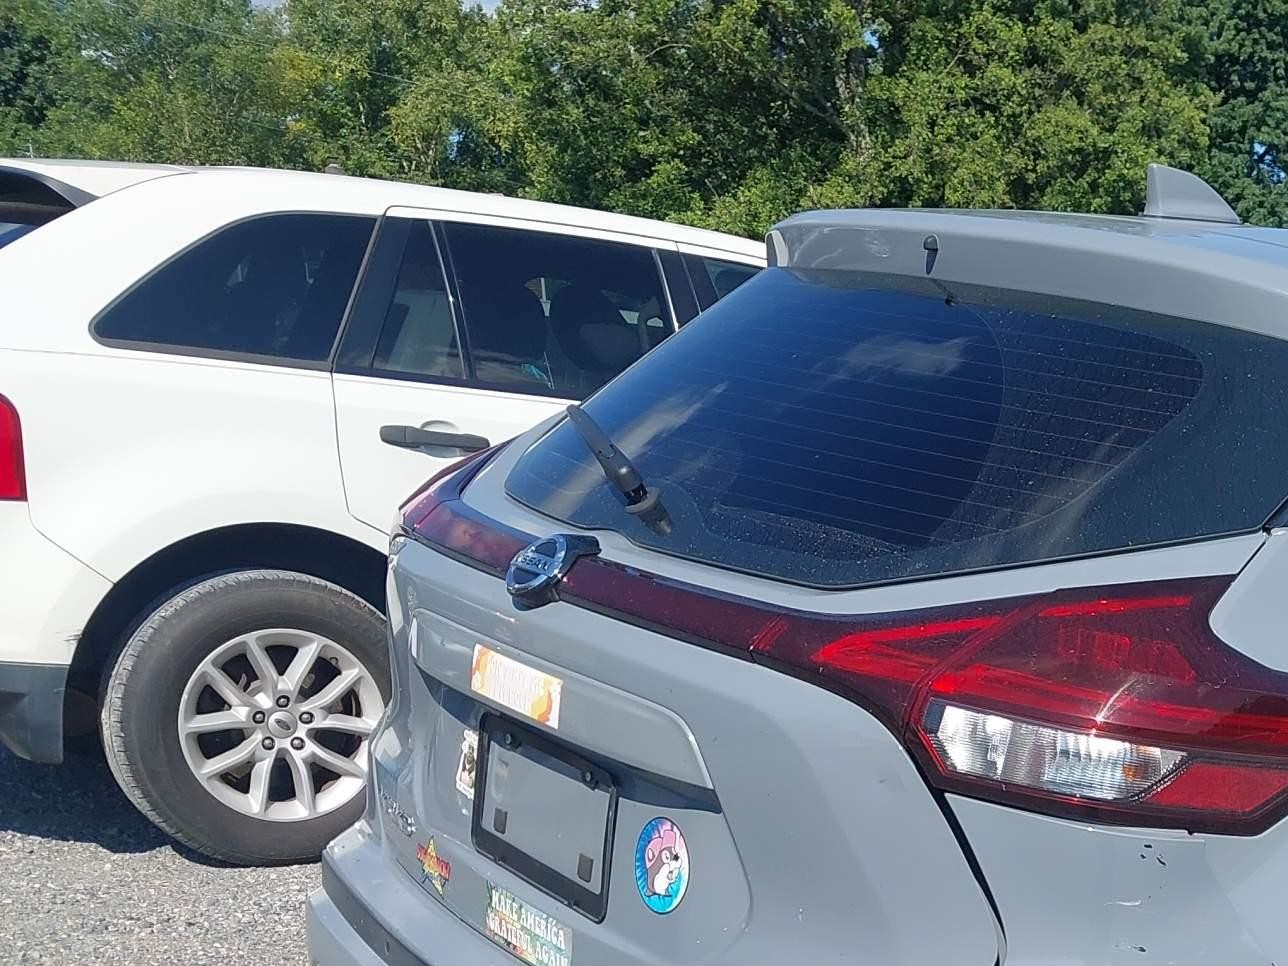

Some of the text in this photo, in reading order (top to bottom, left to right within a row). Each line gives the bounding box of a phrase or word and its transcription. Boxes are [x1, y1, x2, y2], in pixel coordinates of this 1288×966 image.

[487, 912, 533, 954] GRATEFUL
[491, 888, 566, 950] MAKE AMERICA
